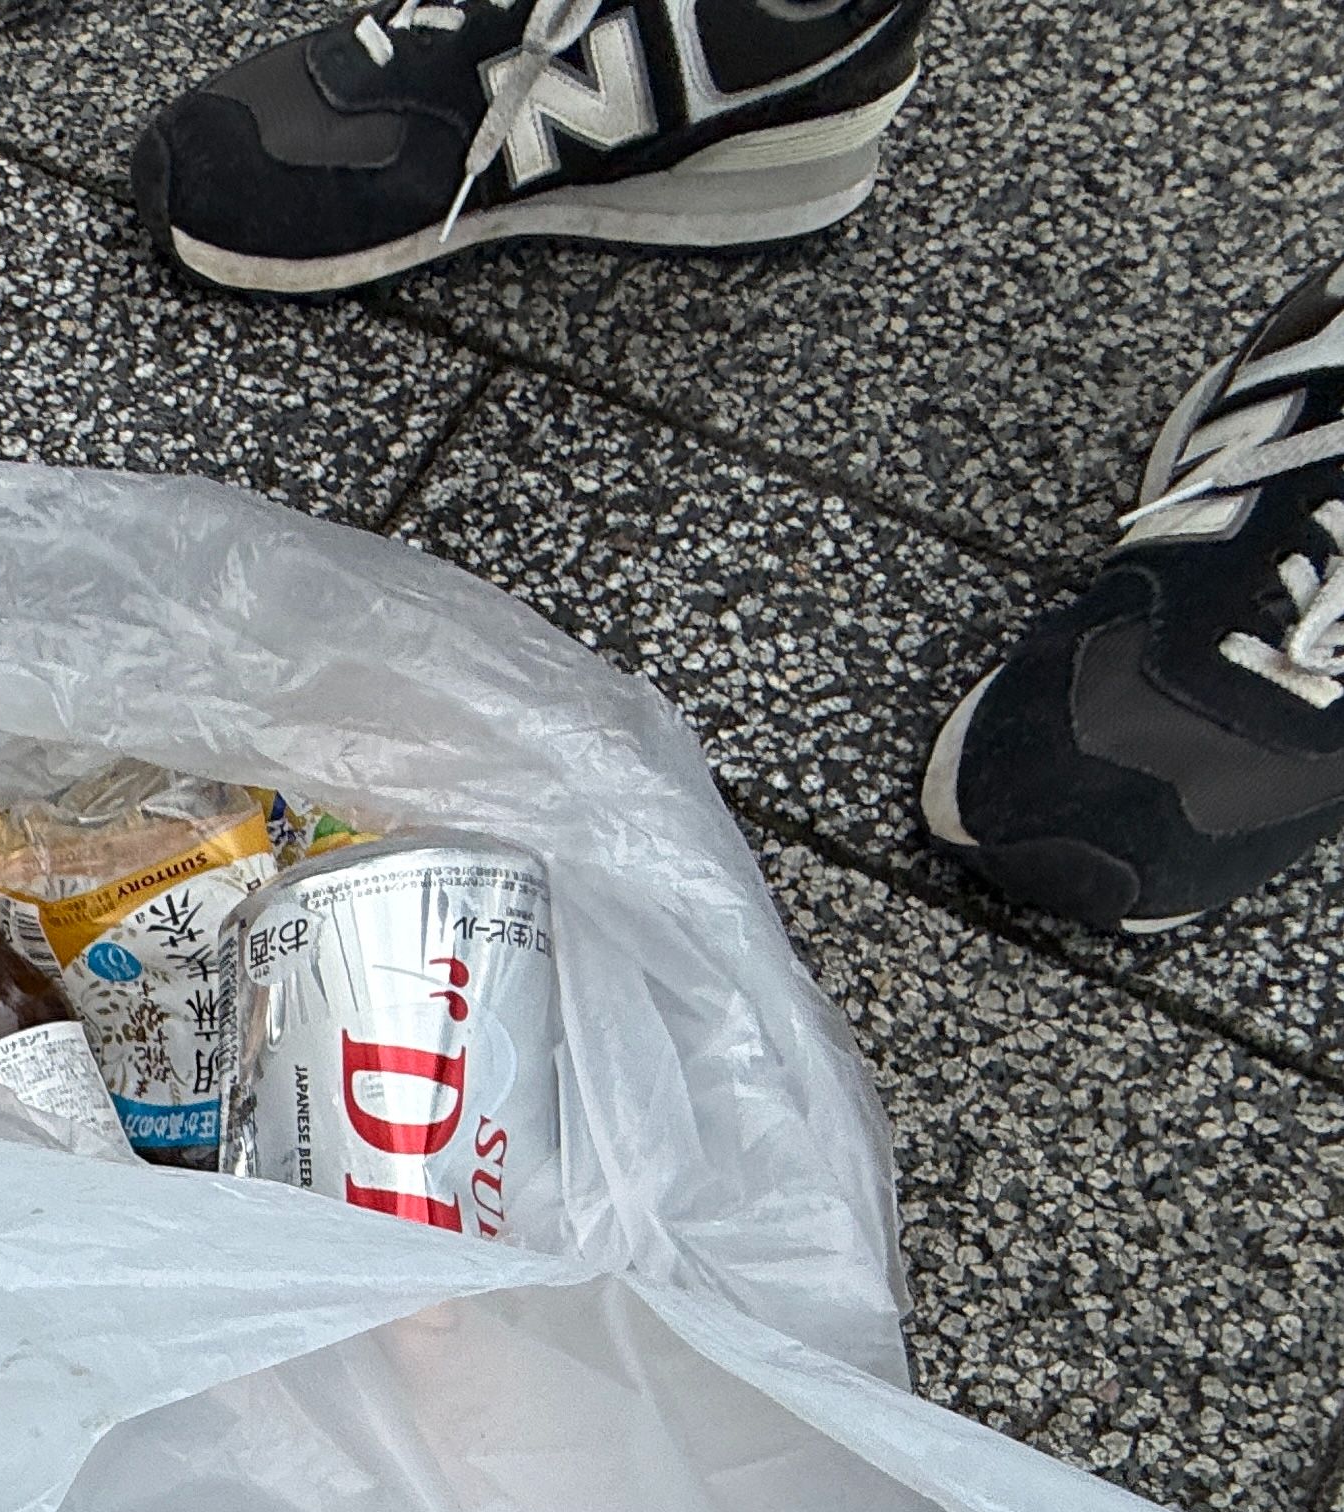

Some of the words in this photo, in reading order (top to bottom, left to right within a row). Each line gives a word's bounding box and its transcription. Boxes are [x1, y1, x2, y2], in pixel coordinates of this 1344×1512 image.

[114, 851, 209, 901] SUNTORY
[250, 919, 311, 969] お酒
[295, 1065, 311, 1146] JAPANESE
[297, 1149, 313, 1187] BEER
